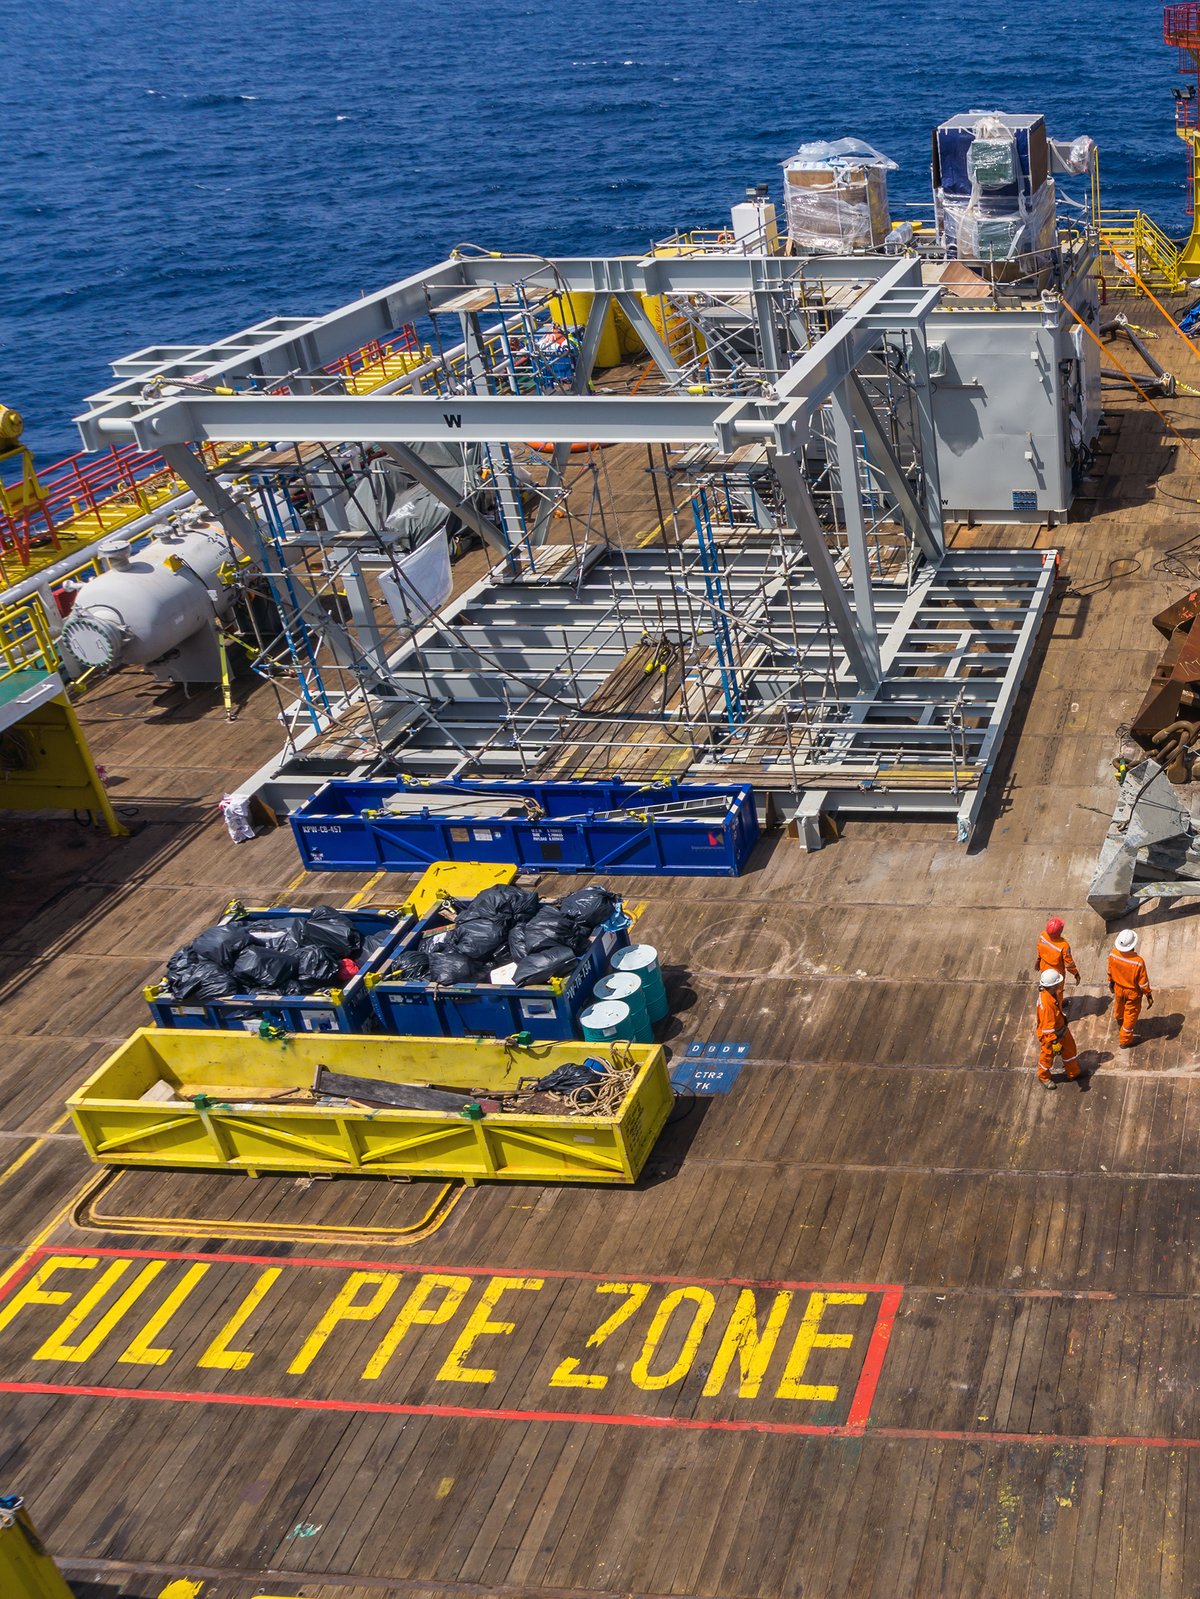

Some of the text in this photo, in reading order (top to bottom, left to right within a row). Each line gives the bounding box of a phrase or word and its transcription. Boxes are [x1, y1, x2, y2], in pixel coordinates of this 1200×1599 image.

[443, 414, 462, 428] W
[695, 1082, 711, 1090] TK
[0, 1256, 283, 1371] FULL
[286, 1271, 545, 1384] PPE
[548, 1282, 867, 1402] ZONE
